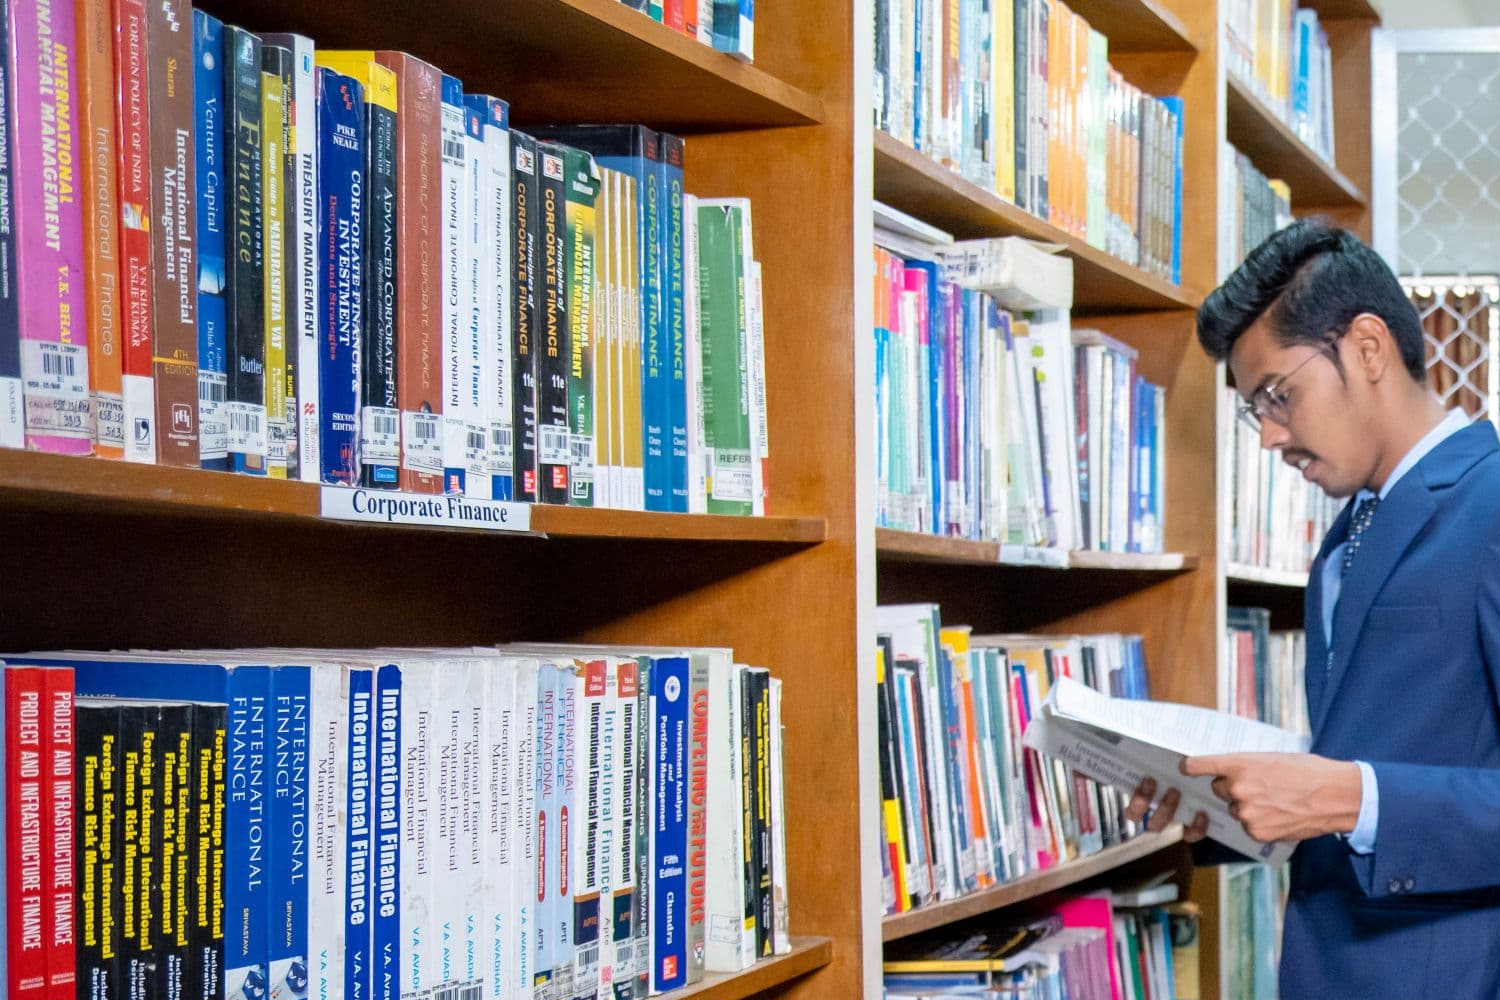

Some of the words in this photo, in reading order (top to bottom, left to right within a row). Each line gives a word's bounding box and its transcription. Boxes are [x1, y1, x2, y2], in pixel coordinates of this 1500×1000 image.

[129, 16, 139, 76] FOREIGN
[168, 57, 177, 97] Sharan
[54, 43, 72, 203] INTERNATIONAL
[129, 79, 140, 130] POLICY
[205, 98, 217, 165] Venture
[336, 124, 356, 137] PIKE
[40, 102, 61, 251] MANAGEMENT
[131, 154, 141, 193] INDIA
[132, 134, 140, 150] OF
[333, 135, 359, 150] NEALE
[97, 127, 113, 260] International
[176, 128, 191, 242] International
[206, 171, 218, 232] Capital
[240, 113, 260, 263] Finance
[303, 153, 313, 227] TREASURY
[163, 166, 176, 281] Management
[351, 170, 361, 290] CORPORATE
[545, 189, 555, 285] CORPORATE
[180, 245, 193, 324] Financial
[304, 232, 315, 340] MANAGEMENT
[339, 220, 349, 347] INVESTMENT
[450, 232, 458, 307] CORPORATE
[102, 272, 114, 355] Finance
[353, 297, 361, 375] FINANCE
[547, 289, 557, 358] FINANCE
[240, 357, 263, 375] Butler
[450, 312, 458, 407] INTERNATIONAL
[552, 375, 564, 388] 11e
[353, 490, 442, 521] Corporate
[447, 498, 507, 523] Finance
[21, 692, 38, 745] PROJECT
[233, 698, 247, 802] FINANCE
[589, 703, 601, 769] International
[21, 752, 38, 778] AND
[85, 756, 97, 811] Finance
[101, 735, 114, 789] Foreign
[249, 697, 264, 891] INTERNATIONAL
[352, 692, 370, 836] International
[588, 771, 599, 819] Financial
[85, 815, 97, 848] Risk
[101, 793, 114, 860] Exchange
[659, 763, 667, 832] Management
[21, 783, 40, 892] INFRASTRUCTURE
[587, 821, 598, 888] Management
[83, 851, 97, 946] Management
[102, 864, 114, 959] International
[351, 840, 368, 925] Finance
[23, 894, 40, 951] FINANCE
[667, 891, 675, 945] Chandra
